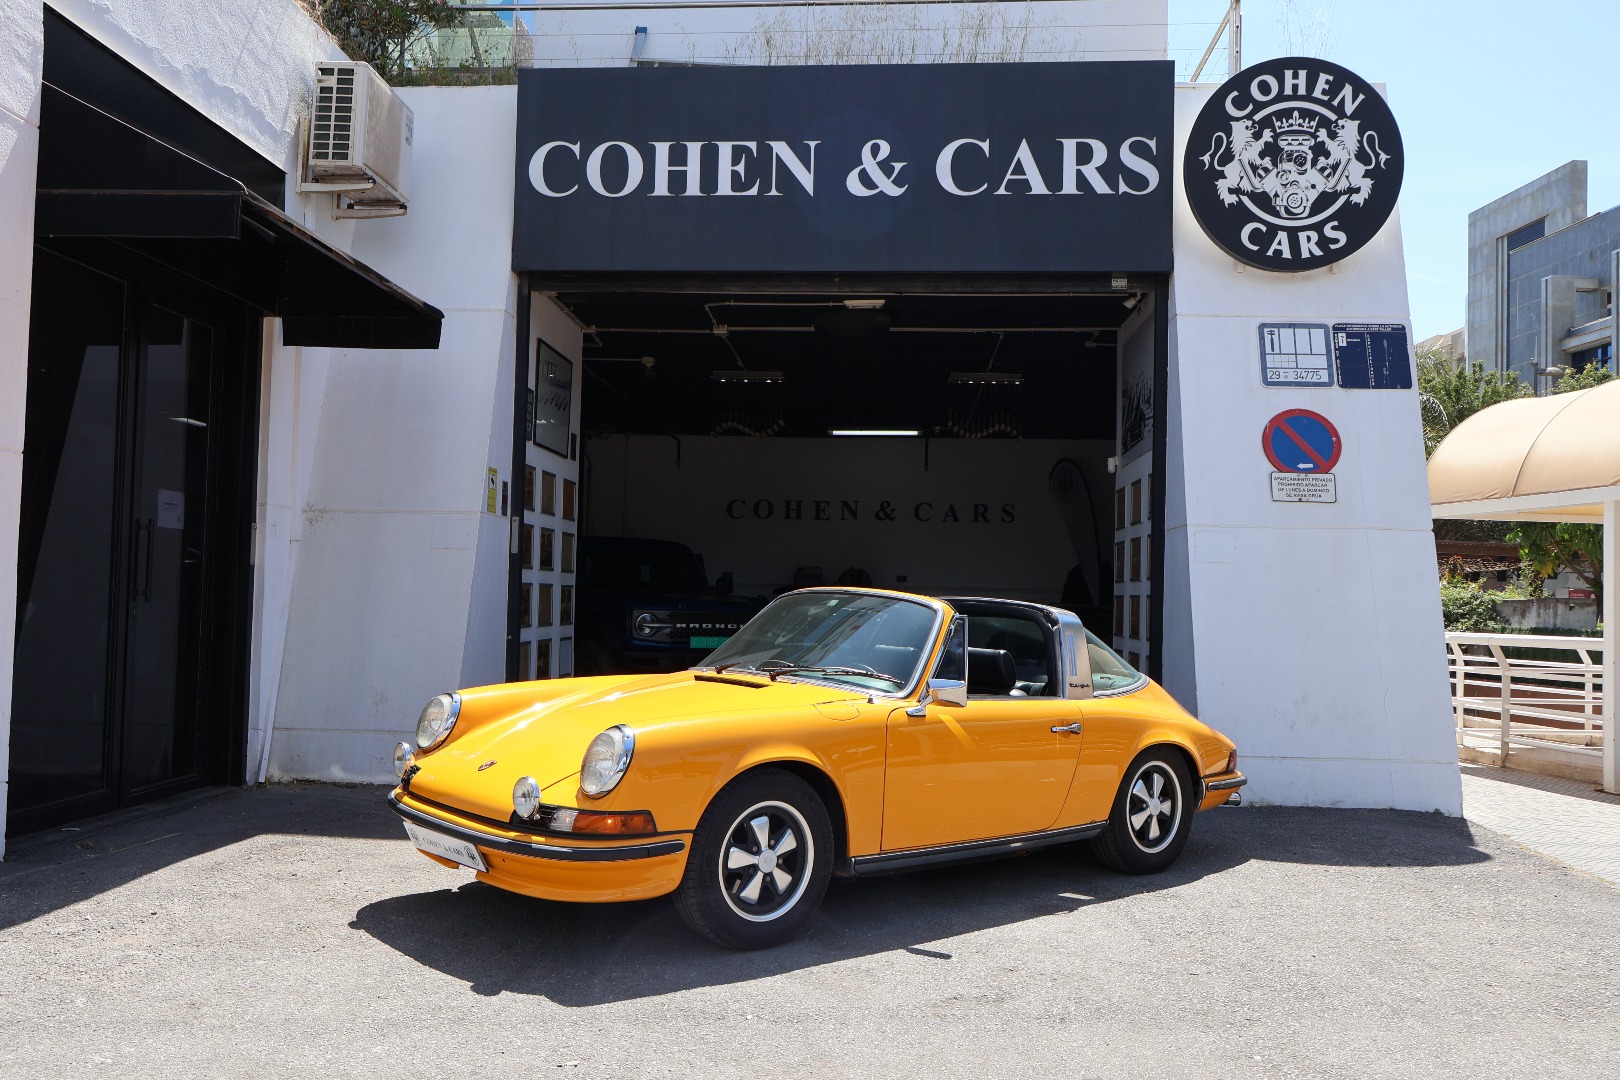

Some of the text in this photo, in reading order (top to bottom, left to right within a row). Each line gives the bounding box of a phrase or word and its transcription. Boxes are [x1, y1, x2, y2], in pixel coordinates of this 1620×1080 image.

[1225, 69, 1366, 118] COHEN
[528, 136, 1160, 198] COHEN & CARS
[1240, 220, 1348, 259] CARS
[1269, 370, 1281, 380] 29
[1293, 370, 1322, 380] 34775
[722, 496, 1017, 525] COHEN & CARS
